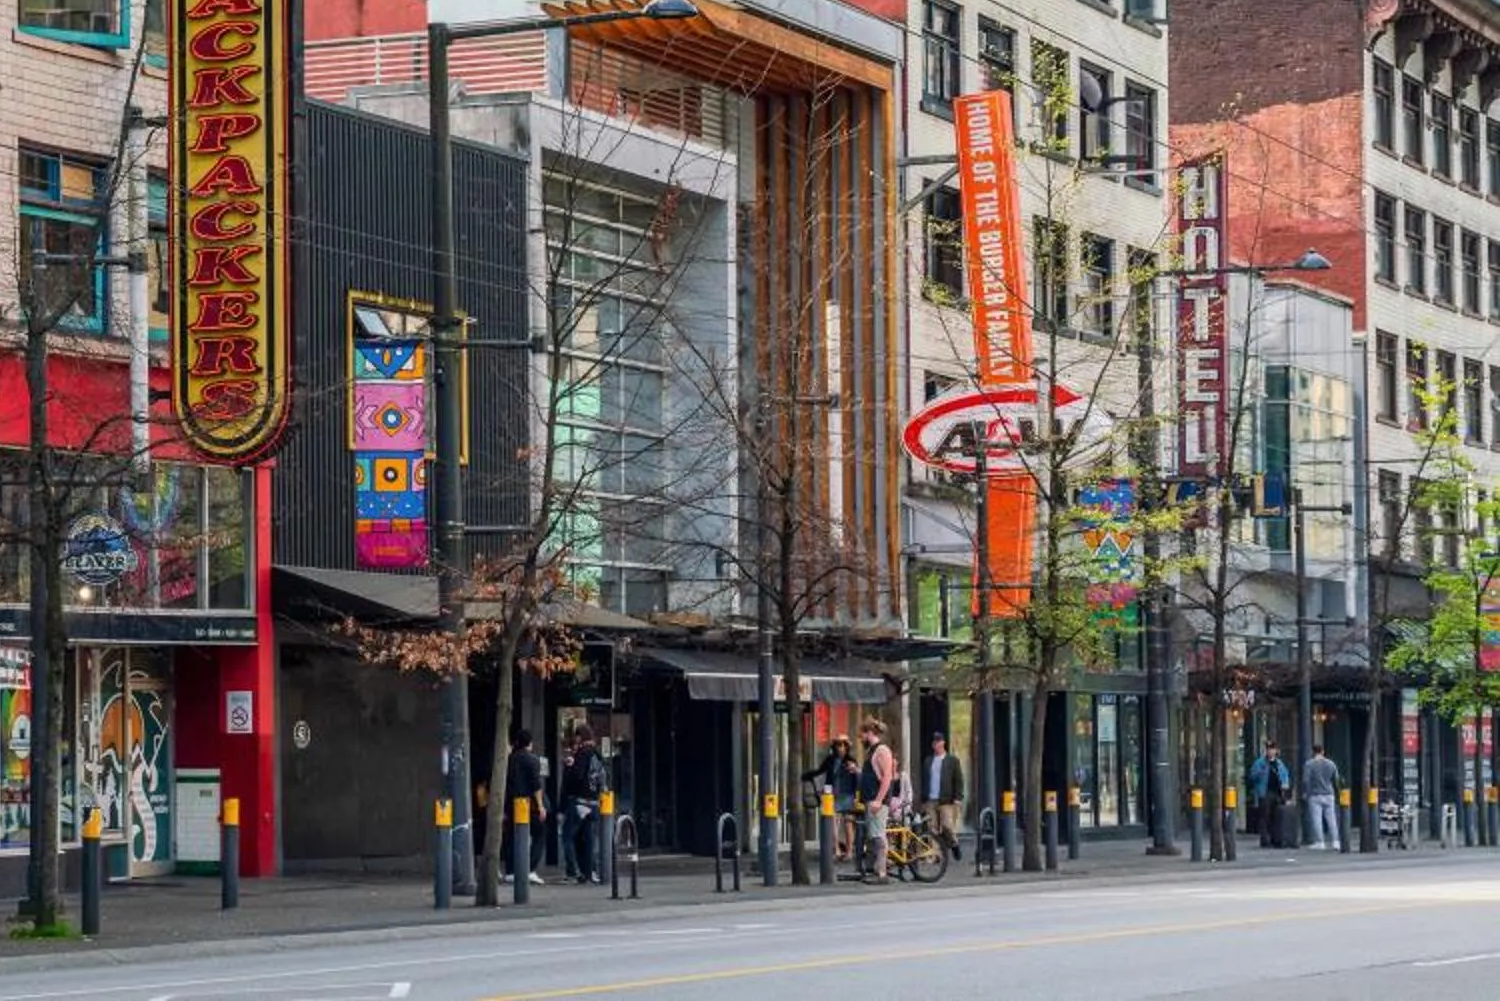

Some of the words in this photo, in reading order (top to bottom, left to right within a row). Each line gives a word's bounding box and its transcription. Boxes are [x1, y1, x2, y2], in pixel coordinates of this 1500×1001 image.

[966, 102, 993, 156] HOME
[971, 161, 997, 185] OF
[975, 189, 1001, 226] THE
[979, 229, 1007, 306] BURGER
[985, 308, 1014, 378] FAMILY
[1182, 165, 1220, 463] HOTEL
